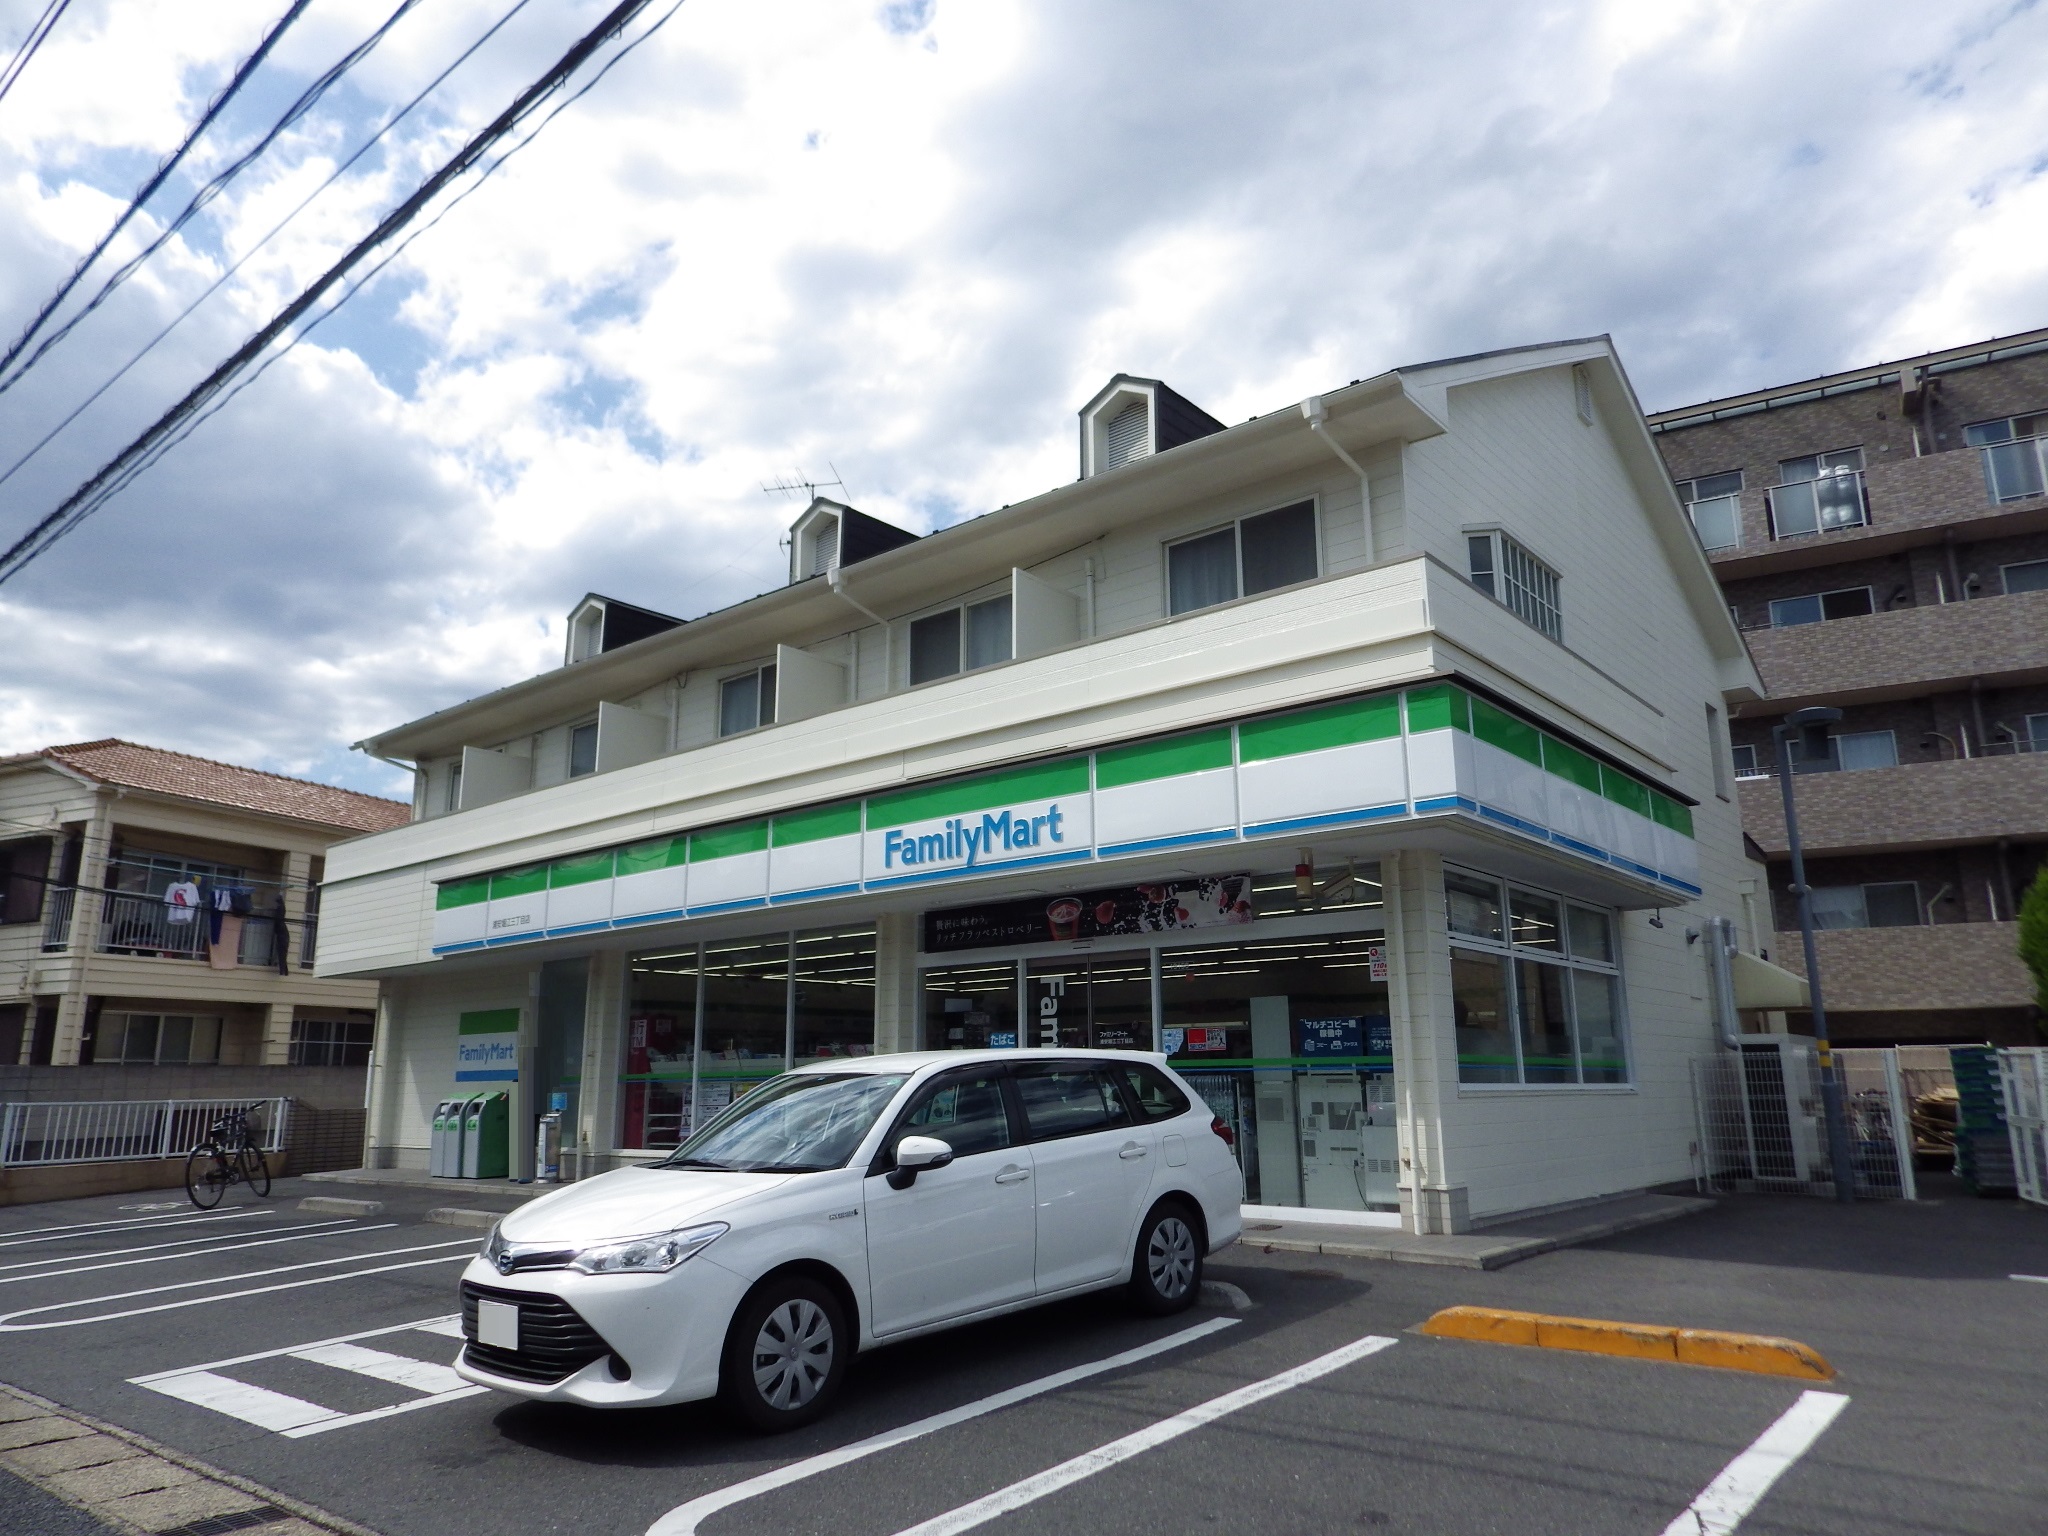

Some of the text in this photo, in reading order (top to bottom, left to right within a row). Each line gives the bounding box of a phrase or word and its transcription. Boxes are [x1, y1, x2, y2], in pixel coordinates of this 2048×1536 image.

[885, 804, 1063, 867] FamilyMart
[990, 1033, 1016, 1047] たばこ
[459, 1043, 514, 1065] FamilyMart
